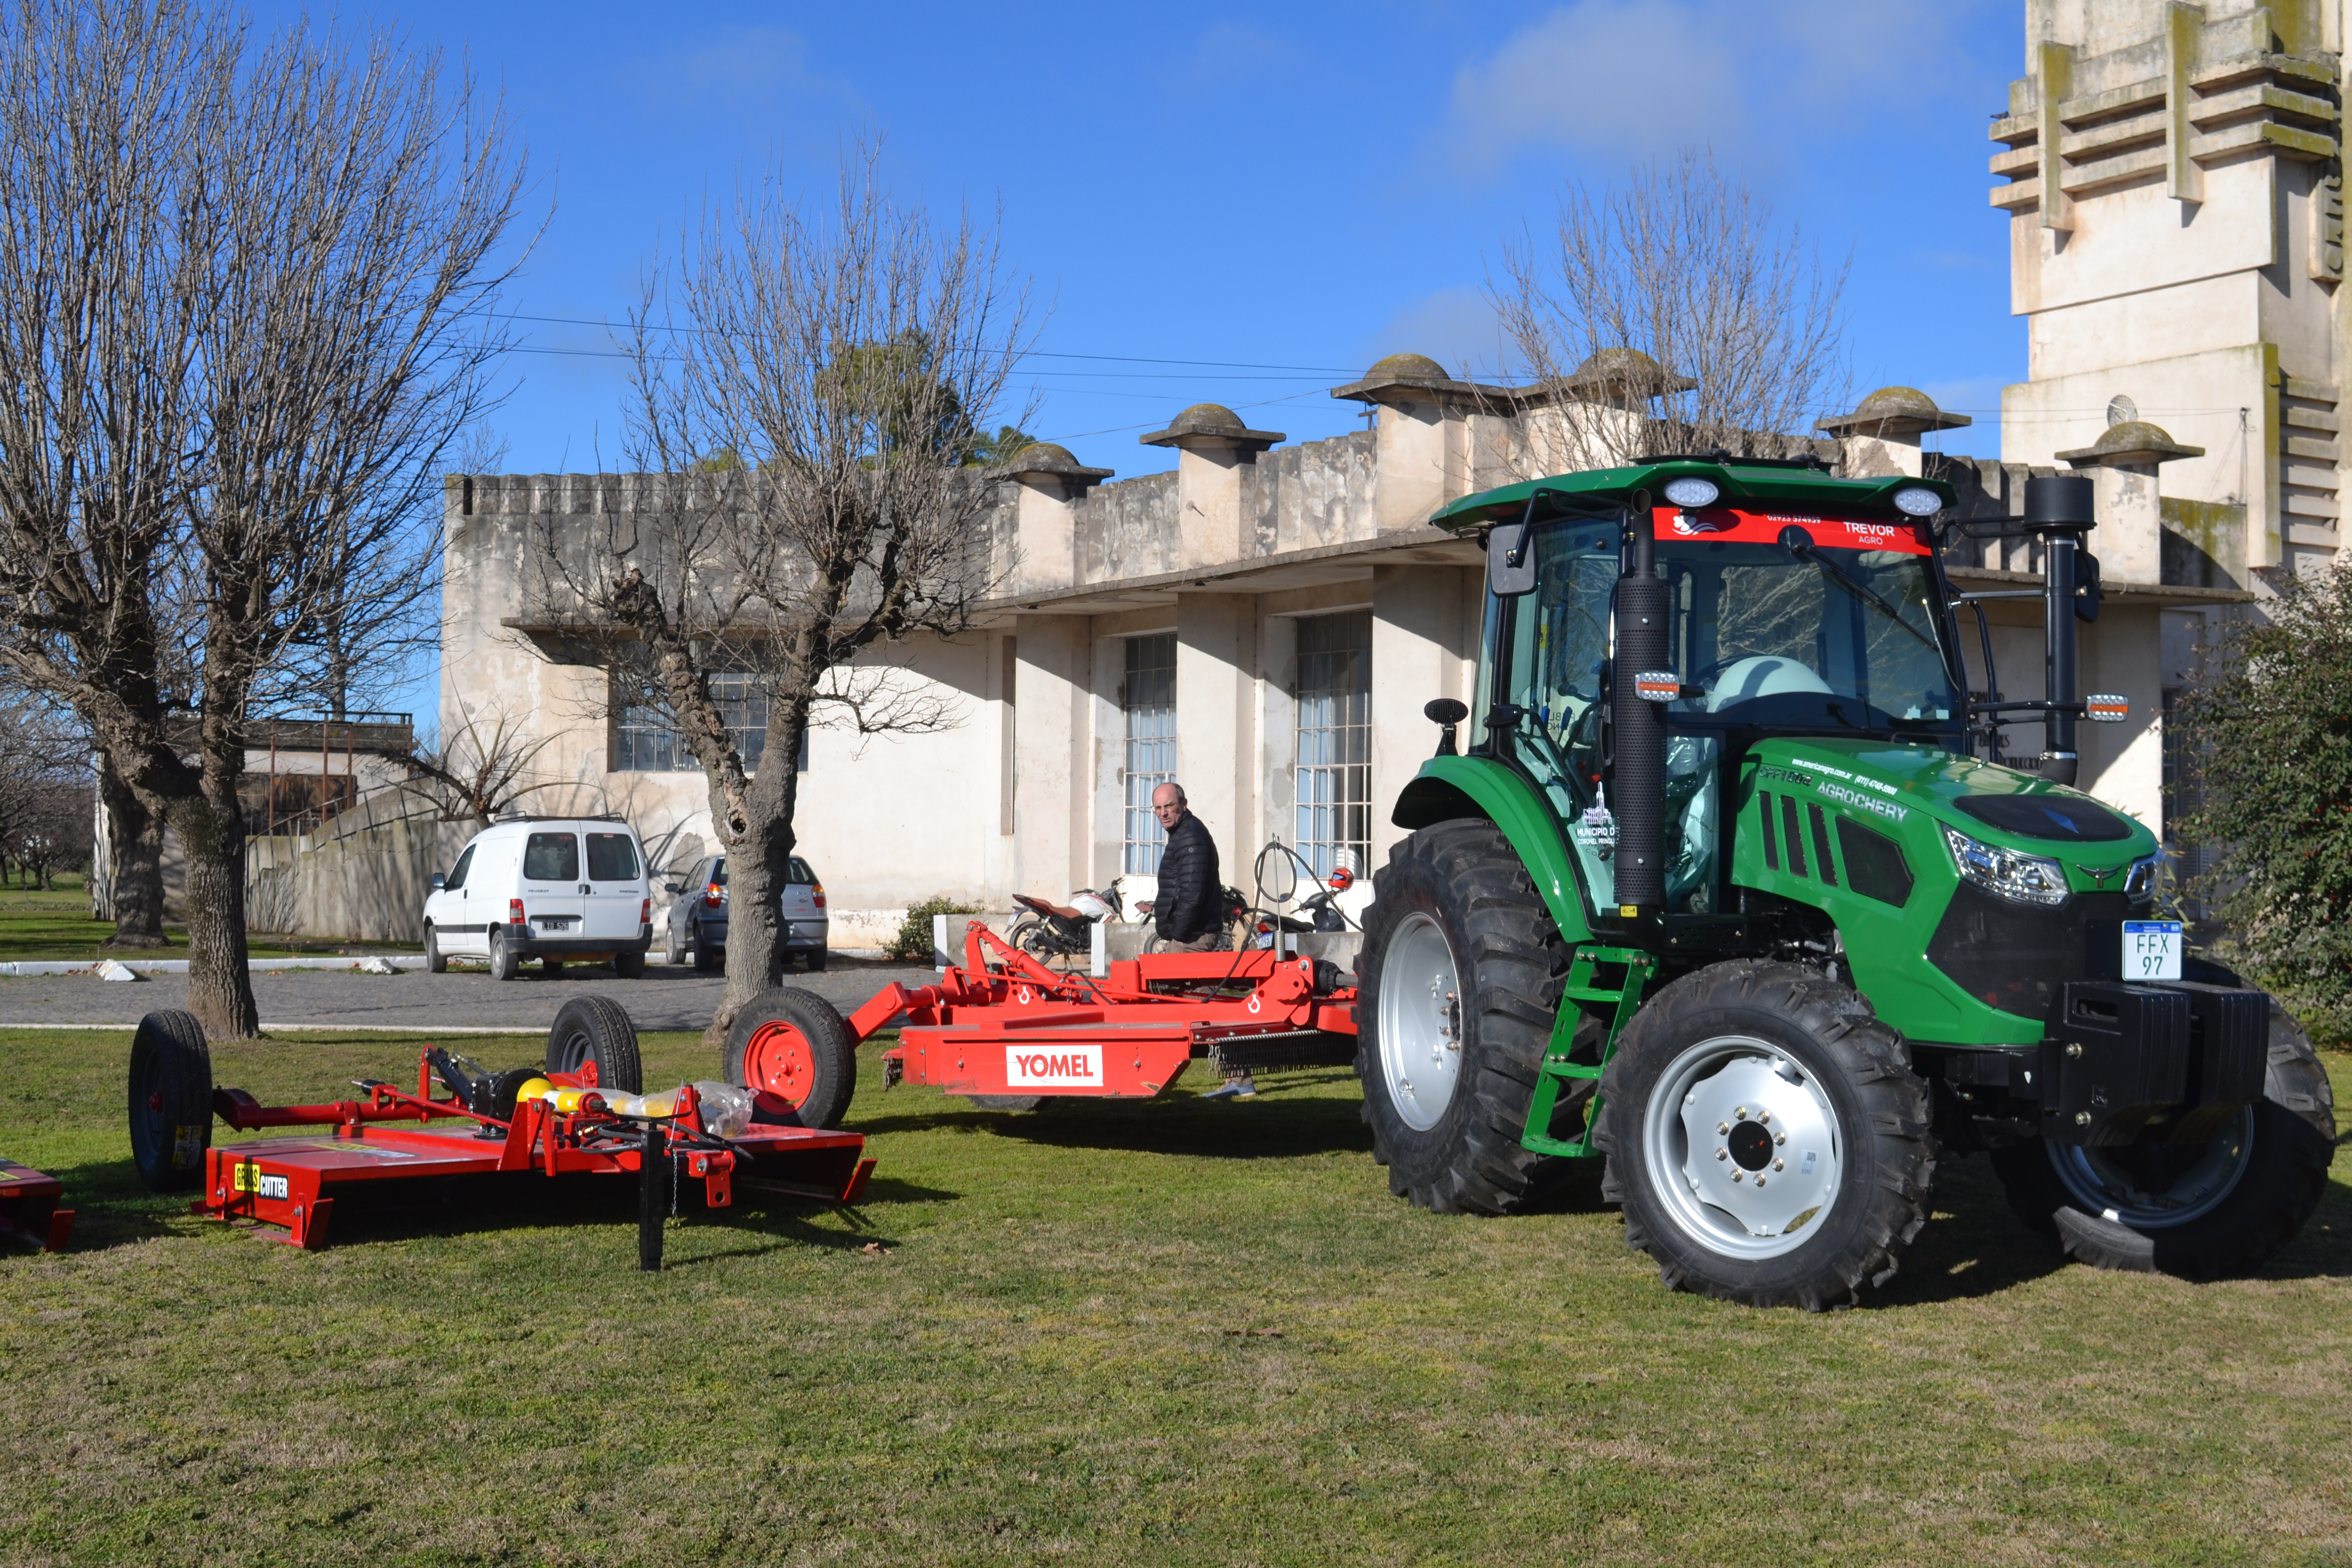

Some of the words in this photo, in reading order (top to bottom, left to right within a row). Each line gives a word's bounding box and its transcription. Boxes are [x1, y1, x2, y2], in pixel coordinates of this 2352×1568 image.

[1793, 515, 1821, 524] 574959
[1843, 522, 1895, 536] TREVOR
[1858, 535, 1883, 545] AGRO
[1854, 774, 1870, 787] (011)
[1816, 781, 1908, 823] AGROCHERY
[1577, 827, 1608, 836] MUNICIPIO
[2137, 934, 2168, 953] FFX
[2142, 956, 2163, 975] 97
[1015, 1054, 1093, 1077] YOMEL
[237, 1167, 258, 1188] GRASS
[260, 1175, 288, 1198] CUTTER
